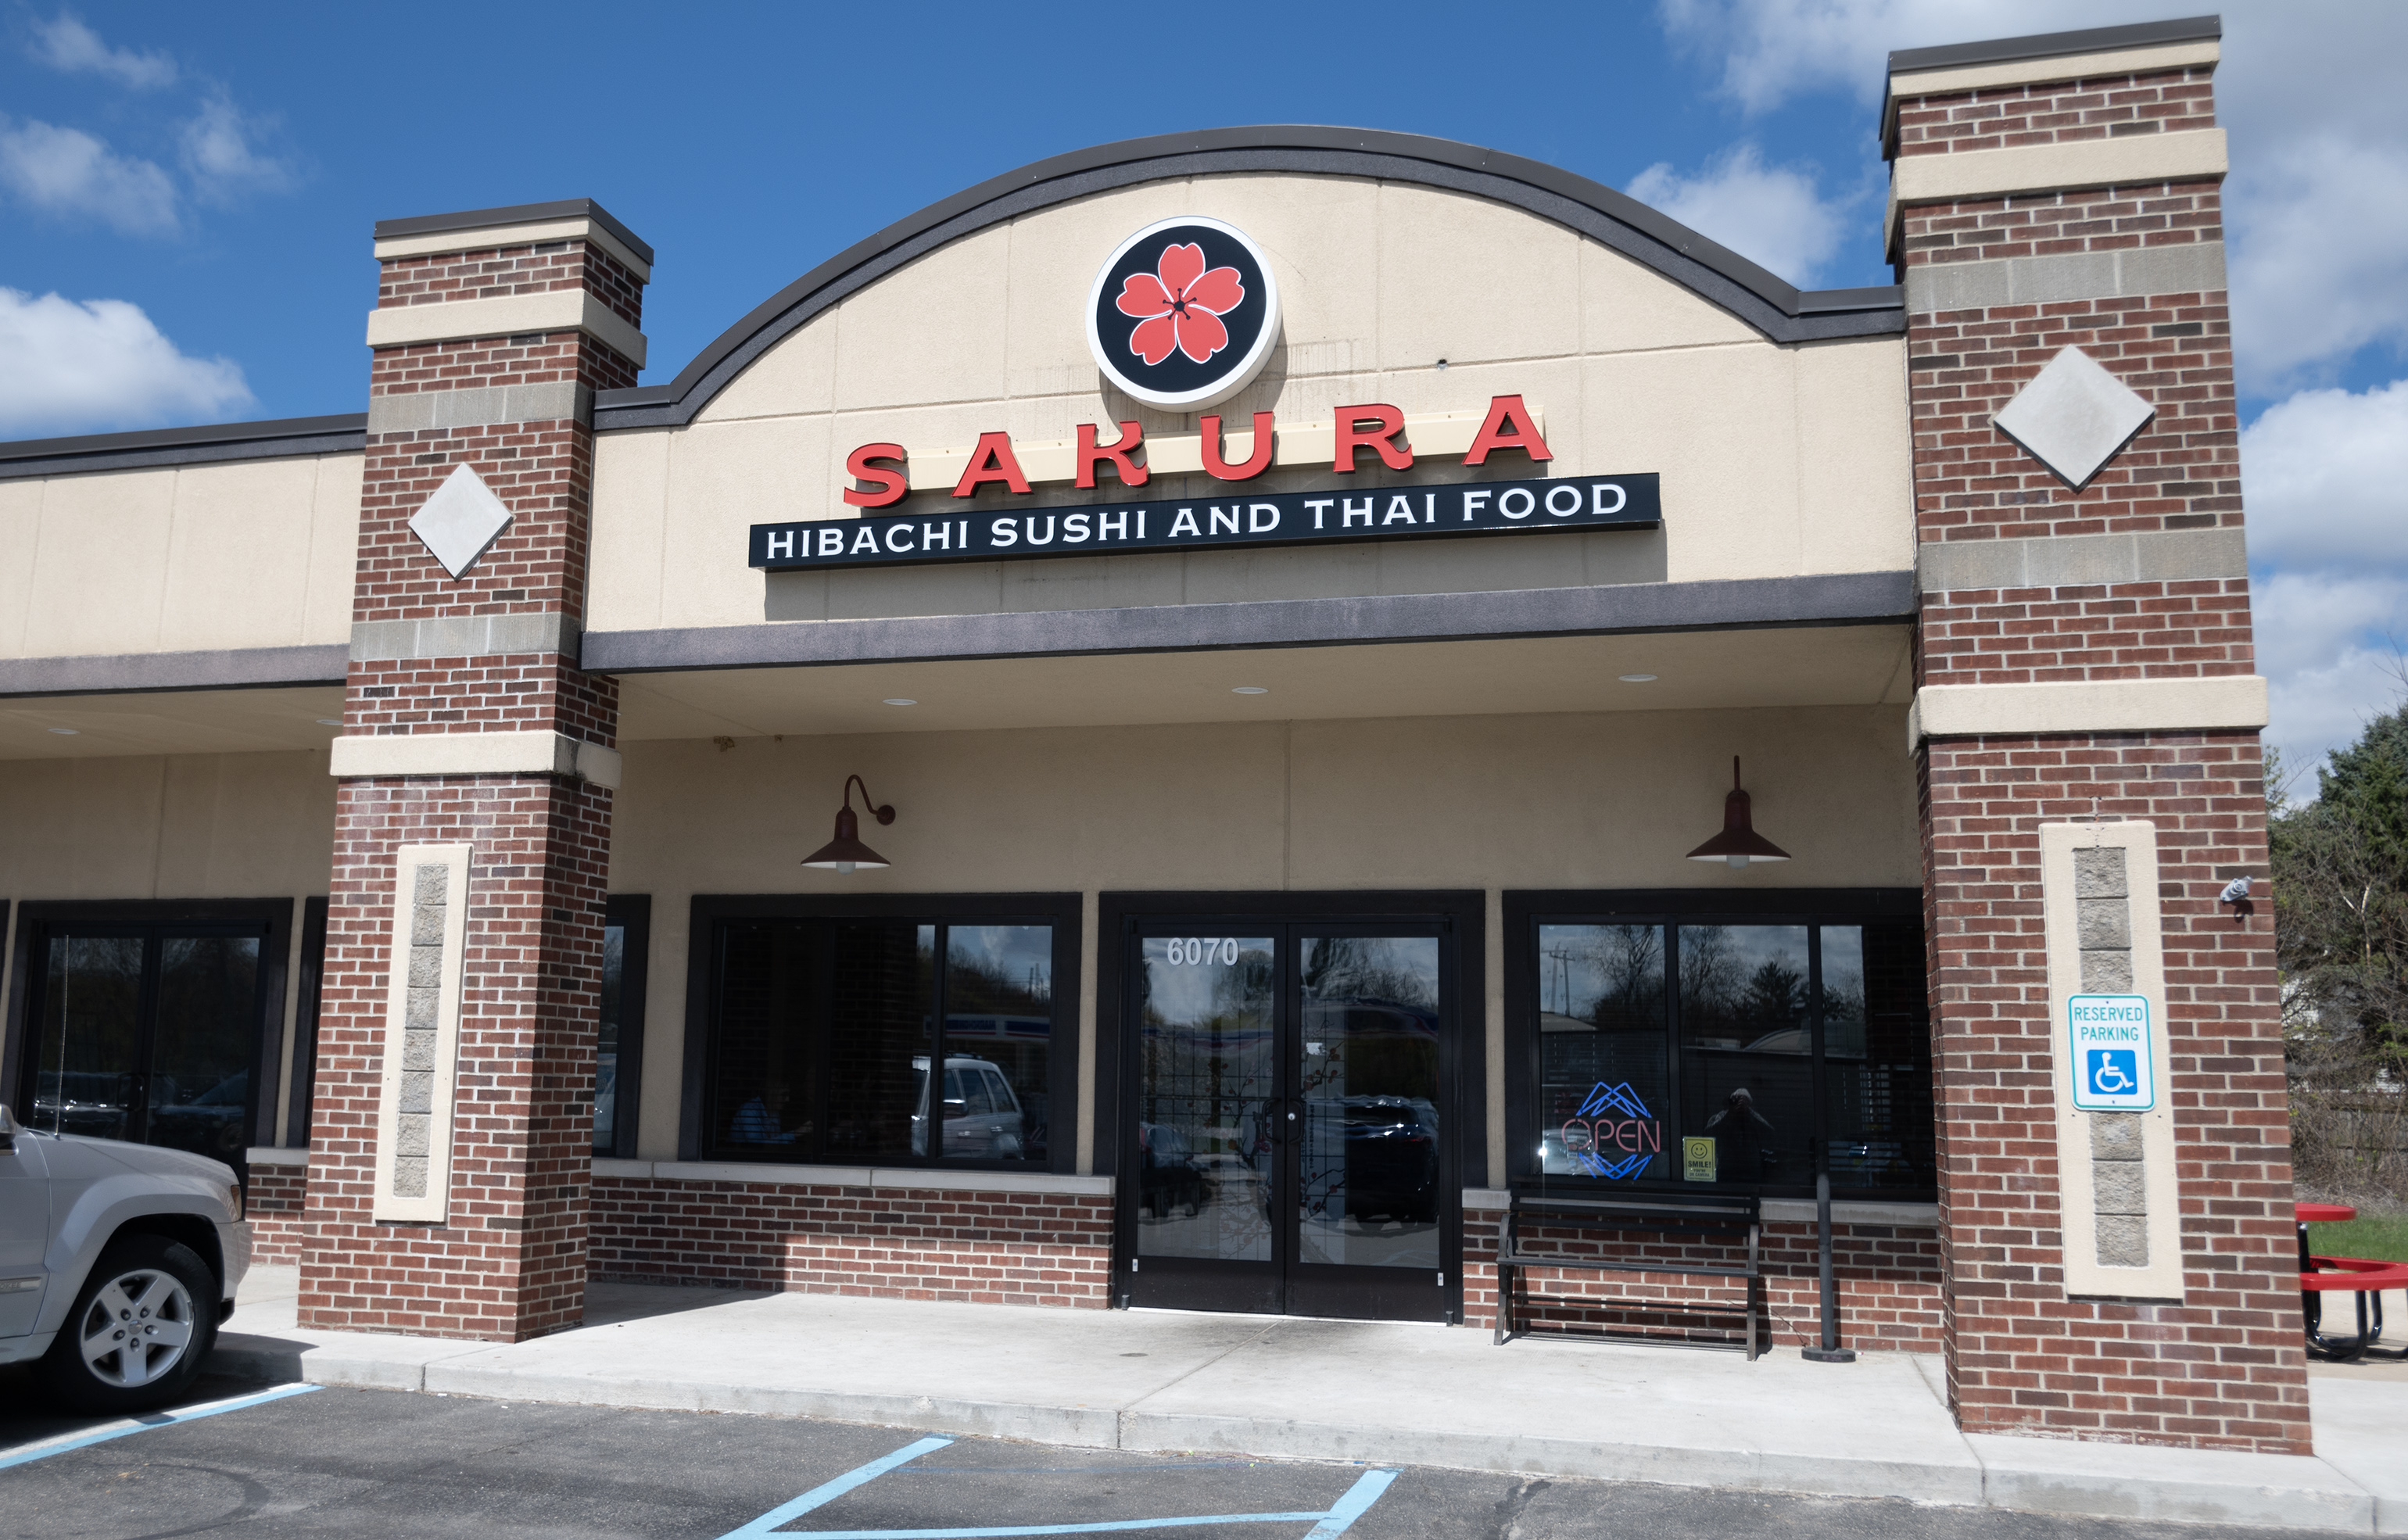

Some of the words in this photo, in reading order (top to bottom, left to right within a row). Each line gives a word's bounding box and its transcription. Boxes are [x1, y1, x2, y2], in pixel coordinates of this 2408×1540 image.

[844, 395, 1553, 510] SAKURA
[767, 521, 968, 559] HIBACHI
[991, 510, 1146, 547] SUSHI
[1167, 503, 1281, 538] AND
[1304, 493, 1435, 529] THAI
[1463, 484, 1626, 521] FOOD
[1167, 937, 1239, 966] 6070
[2074, 1007, 2142, 1021] RESERVED
[2080, 1026, 2138, 1040] PARKING
[1561, 1119, 1661, 1153] OPEN
